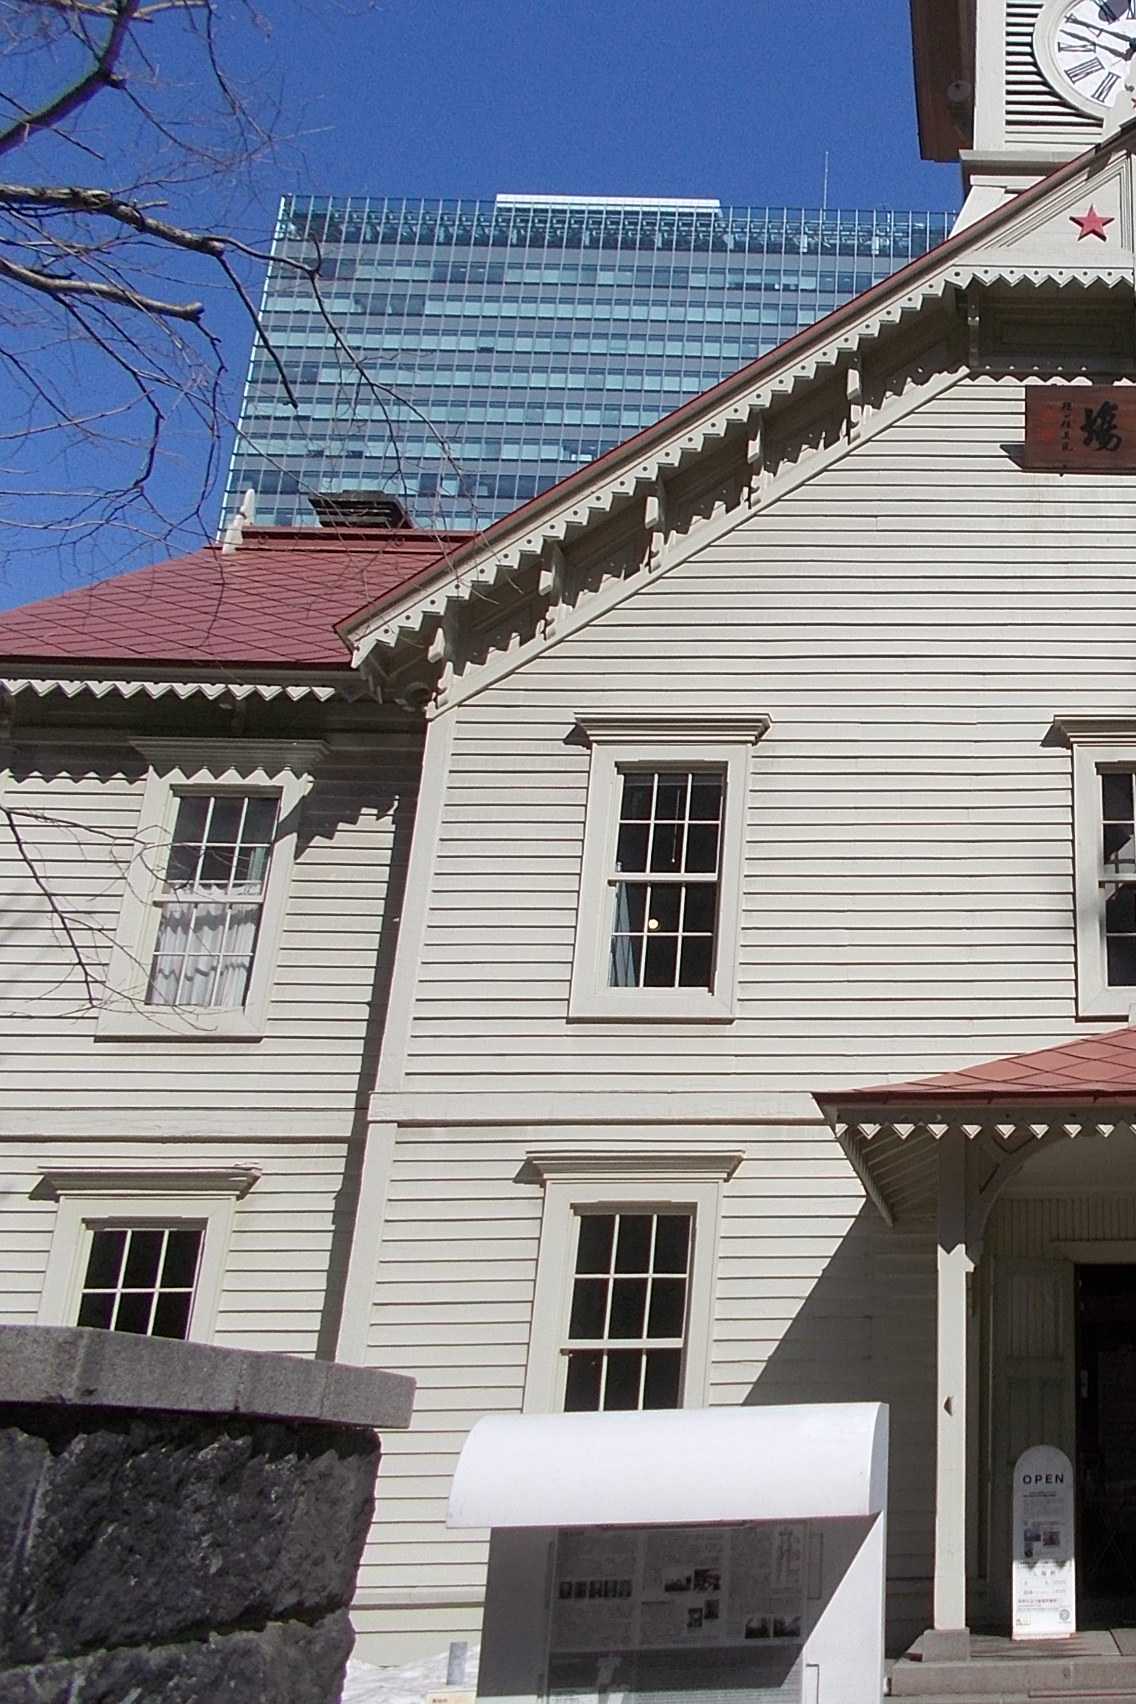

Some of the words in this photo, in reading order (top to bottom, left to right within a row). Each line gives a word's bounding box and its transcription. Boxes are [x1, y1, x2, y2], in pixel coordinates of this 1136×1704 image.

[1064, 56, 1105, 84] VIII
[1091, 71, 1122, 103] VII
[1022, 1473, 1065, 1485] OPEN
